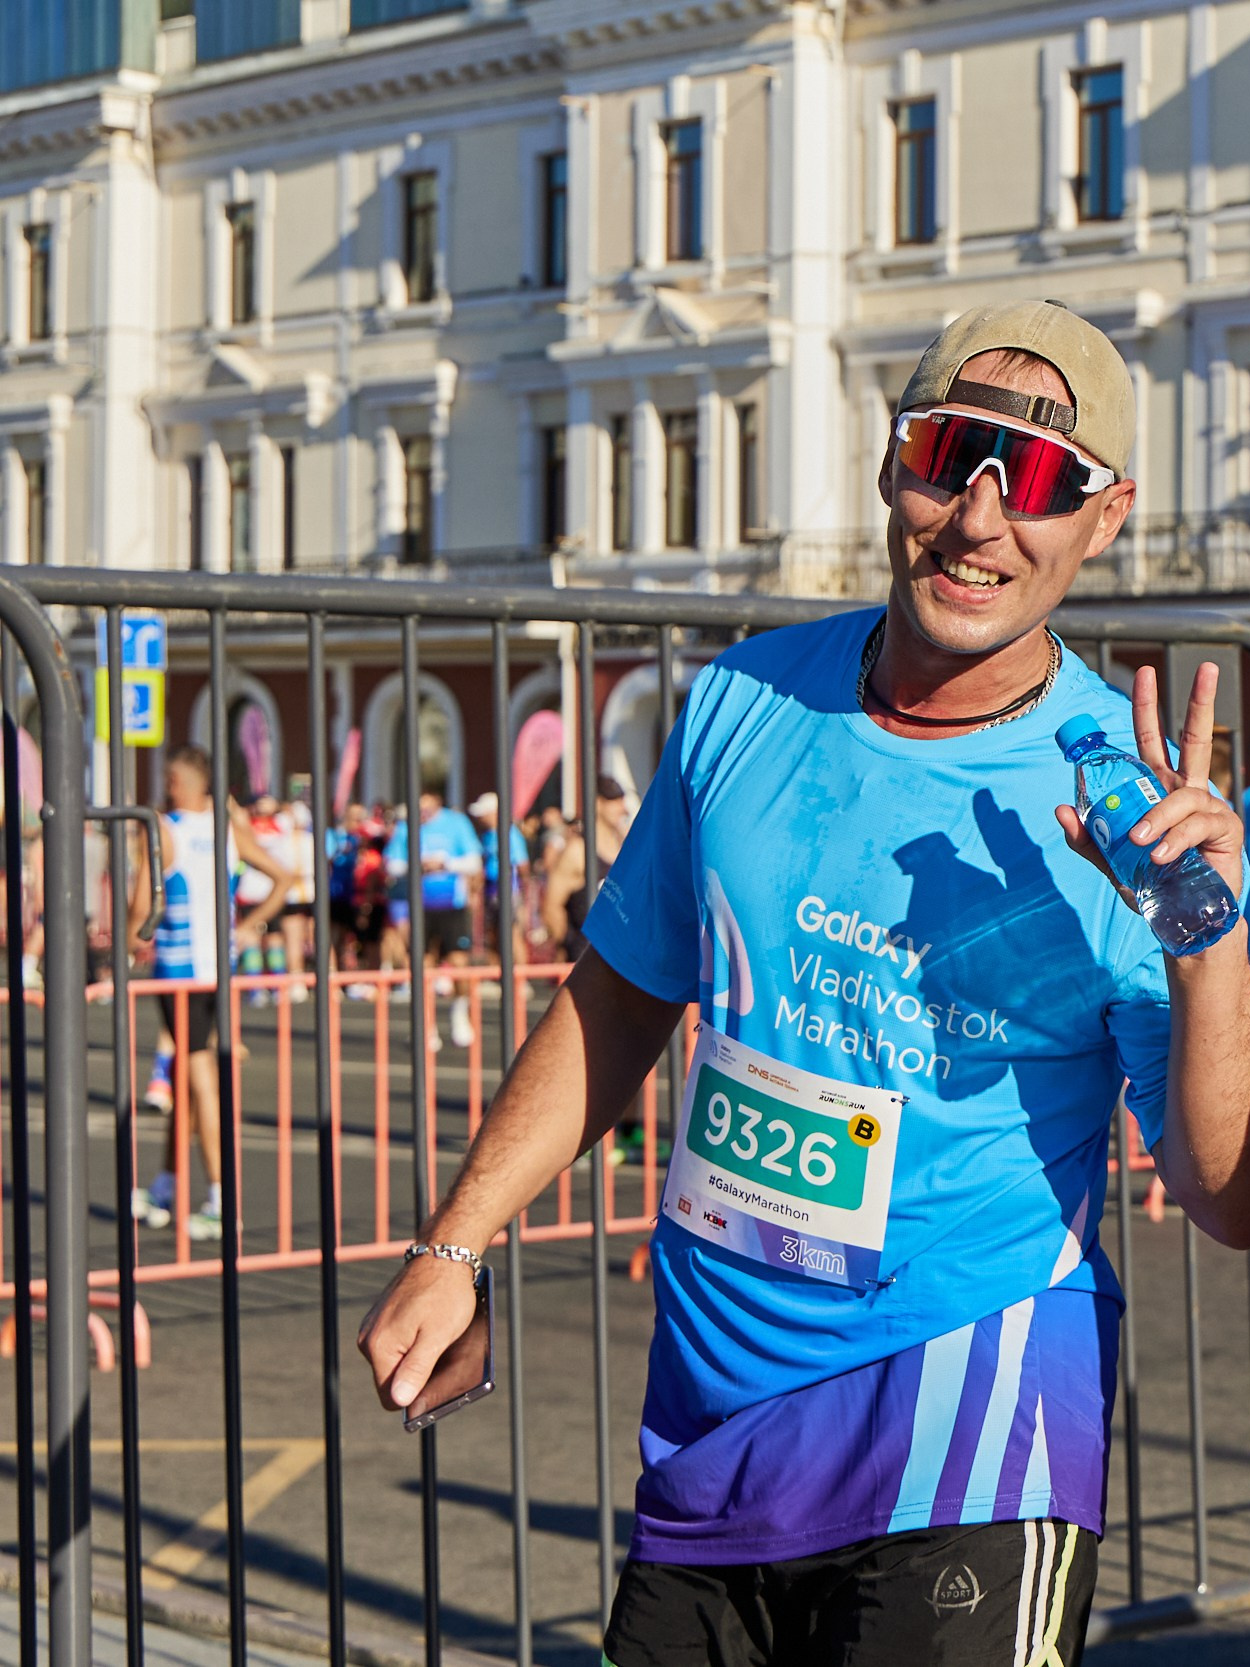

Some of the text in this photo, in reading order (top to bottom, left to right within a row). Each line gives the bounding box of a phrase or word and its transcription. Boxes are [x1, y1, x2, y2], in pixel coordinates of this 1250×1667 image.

[796, 895, 933, 980] Galaxy
[789, 946, 1010, 1044] Vladivostok
[774, 995, 952, 1080] Marathon
[747, 1063, 769, 1081] DNS
[704, 1092, 838, 1187] 9326
[854, 1117, 875, 1141] B
[708, 1174, 809, 1222] #GalaxyMarathon
[779, 1234, 846, 1276] 3km
[941, 1589, 971, 1600] SPORT
